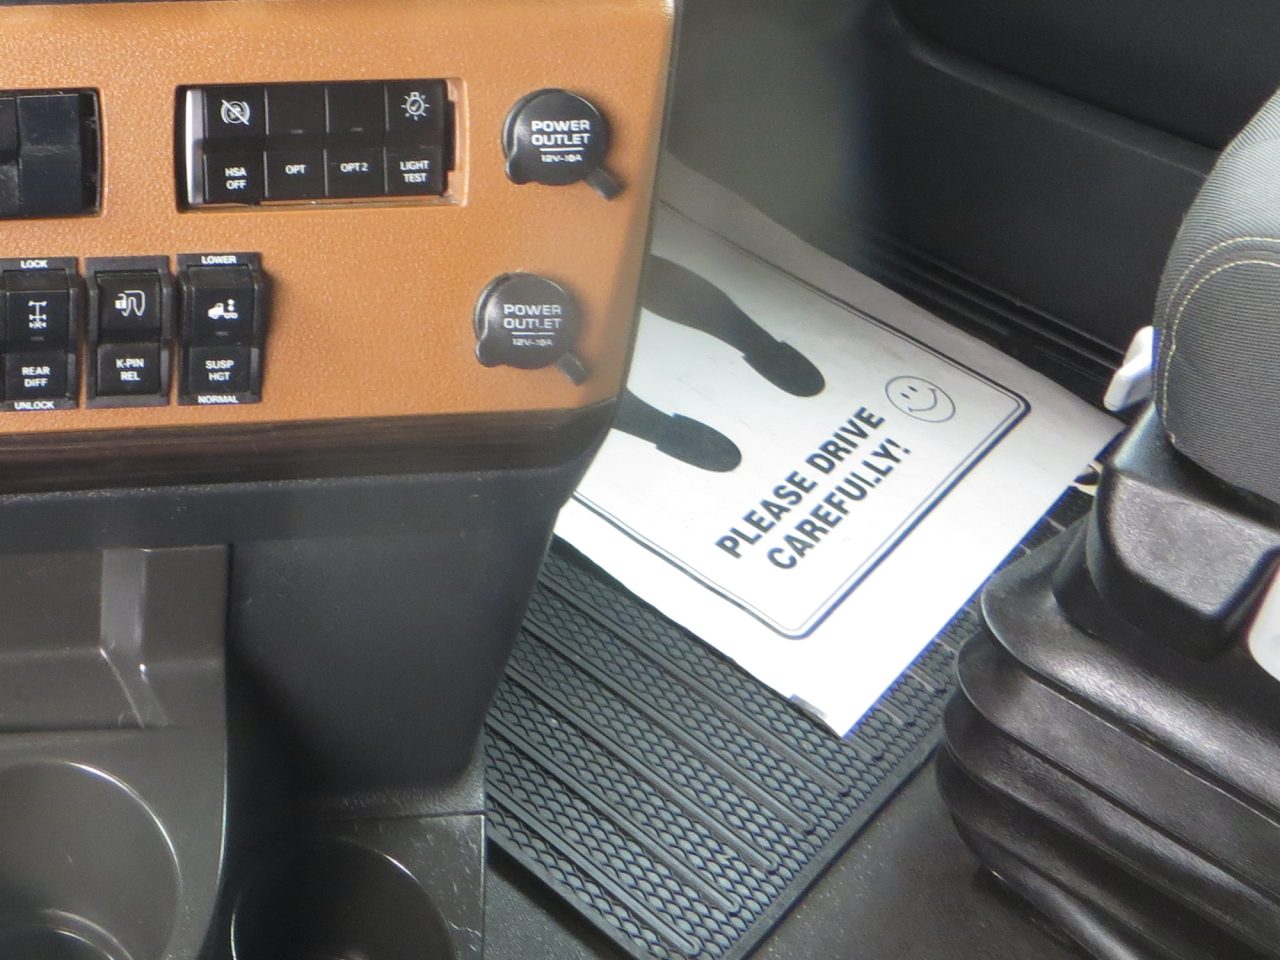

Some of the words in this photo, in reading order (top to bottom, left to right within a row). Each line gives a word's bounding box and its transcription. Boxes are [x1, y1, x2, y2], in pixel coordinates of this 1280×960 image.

[531, 119, 591, 132] POWER
[531, 133, 592, 146] OUTLET
[284, 163, 307, 175] OPT
[339, 161, 361, 173] OPT
[399, 159, 430, 171] LIGHT
[224, 166, 247, 178] HSA
[403, 172, 429, 183] TEST
[226, 179, 247, 191] OFF
[20, 259, 49, 269] LOCK
[200, 254, 238, 265] LOWER
[503, 303, 562, 316] POWER
[502, 317, 563, 330] OUTLET
[115, 358, 145, 369] K-PIN
[204, 359, 235, 370] SUSP
[21, 366, 51, 377] REAR
[120, 370, 141, 382] REL
[208, 370, 232, 382] HGT
[23, 377, 49, 388] DIFF
[14, 400, 55, 410] UNLOCK
[197, 394, 240, 404] NORMAL
[714, 470, 818, 559] PLEASE
[804, 406, 886, 475] DRIVE
[766, 437, 912, 570] CAREFULLY!
